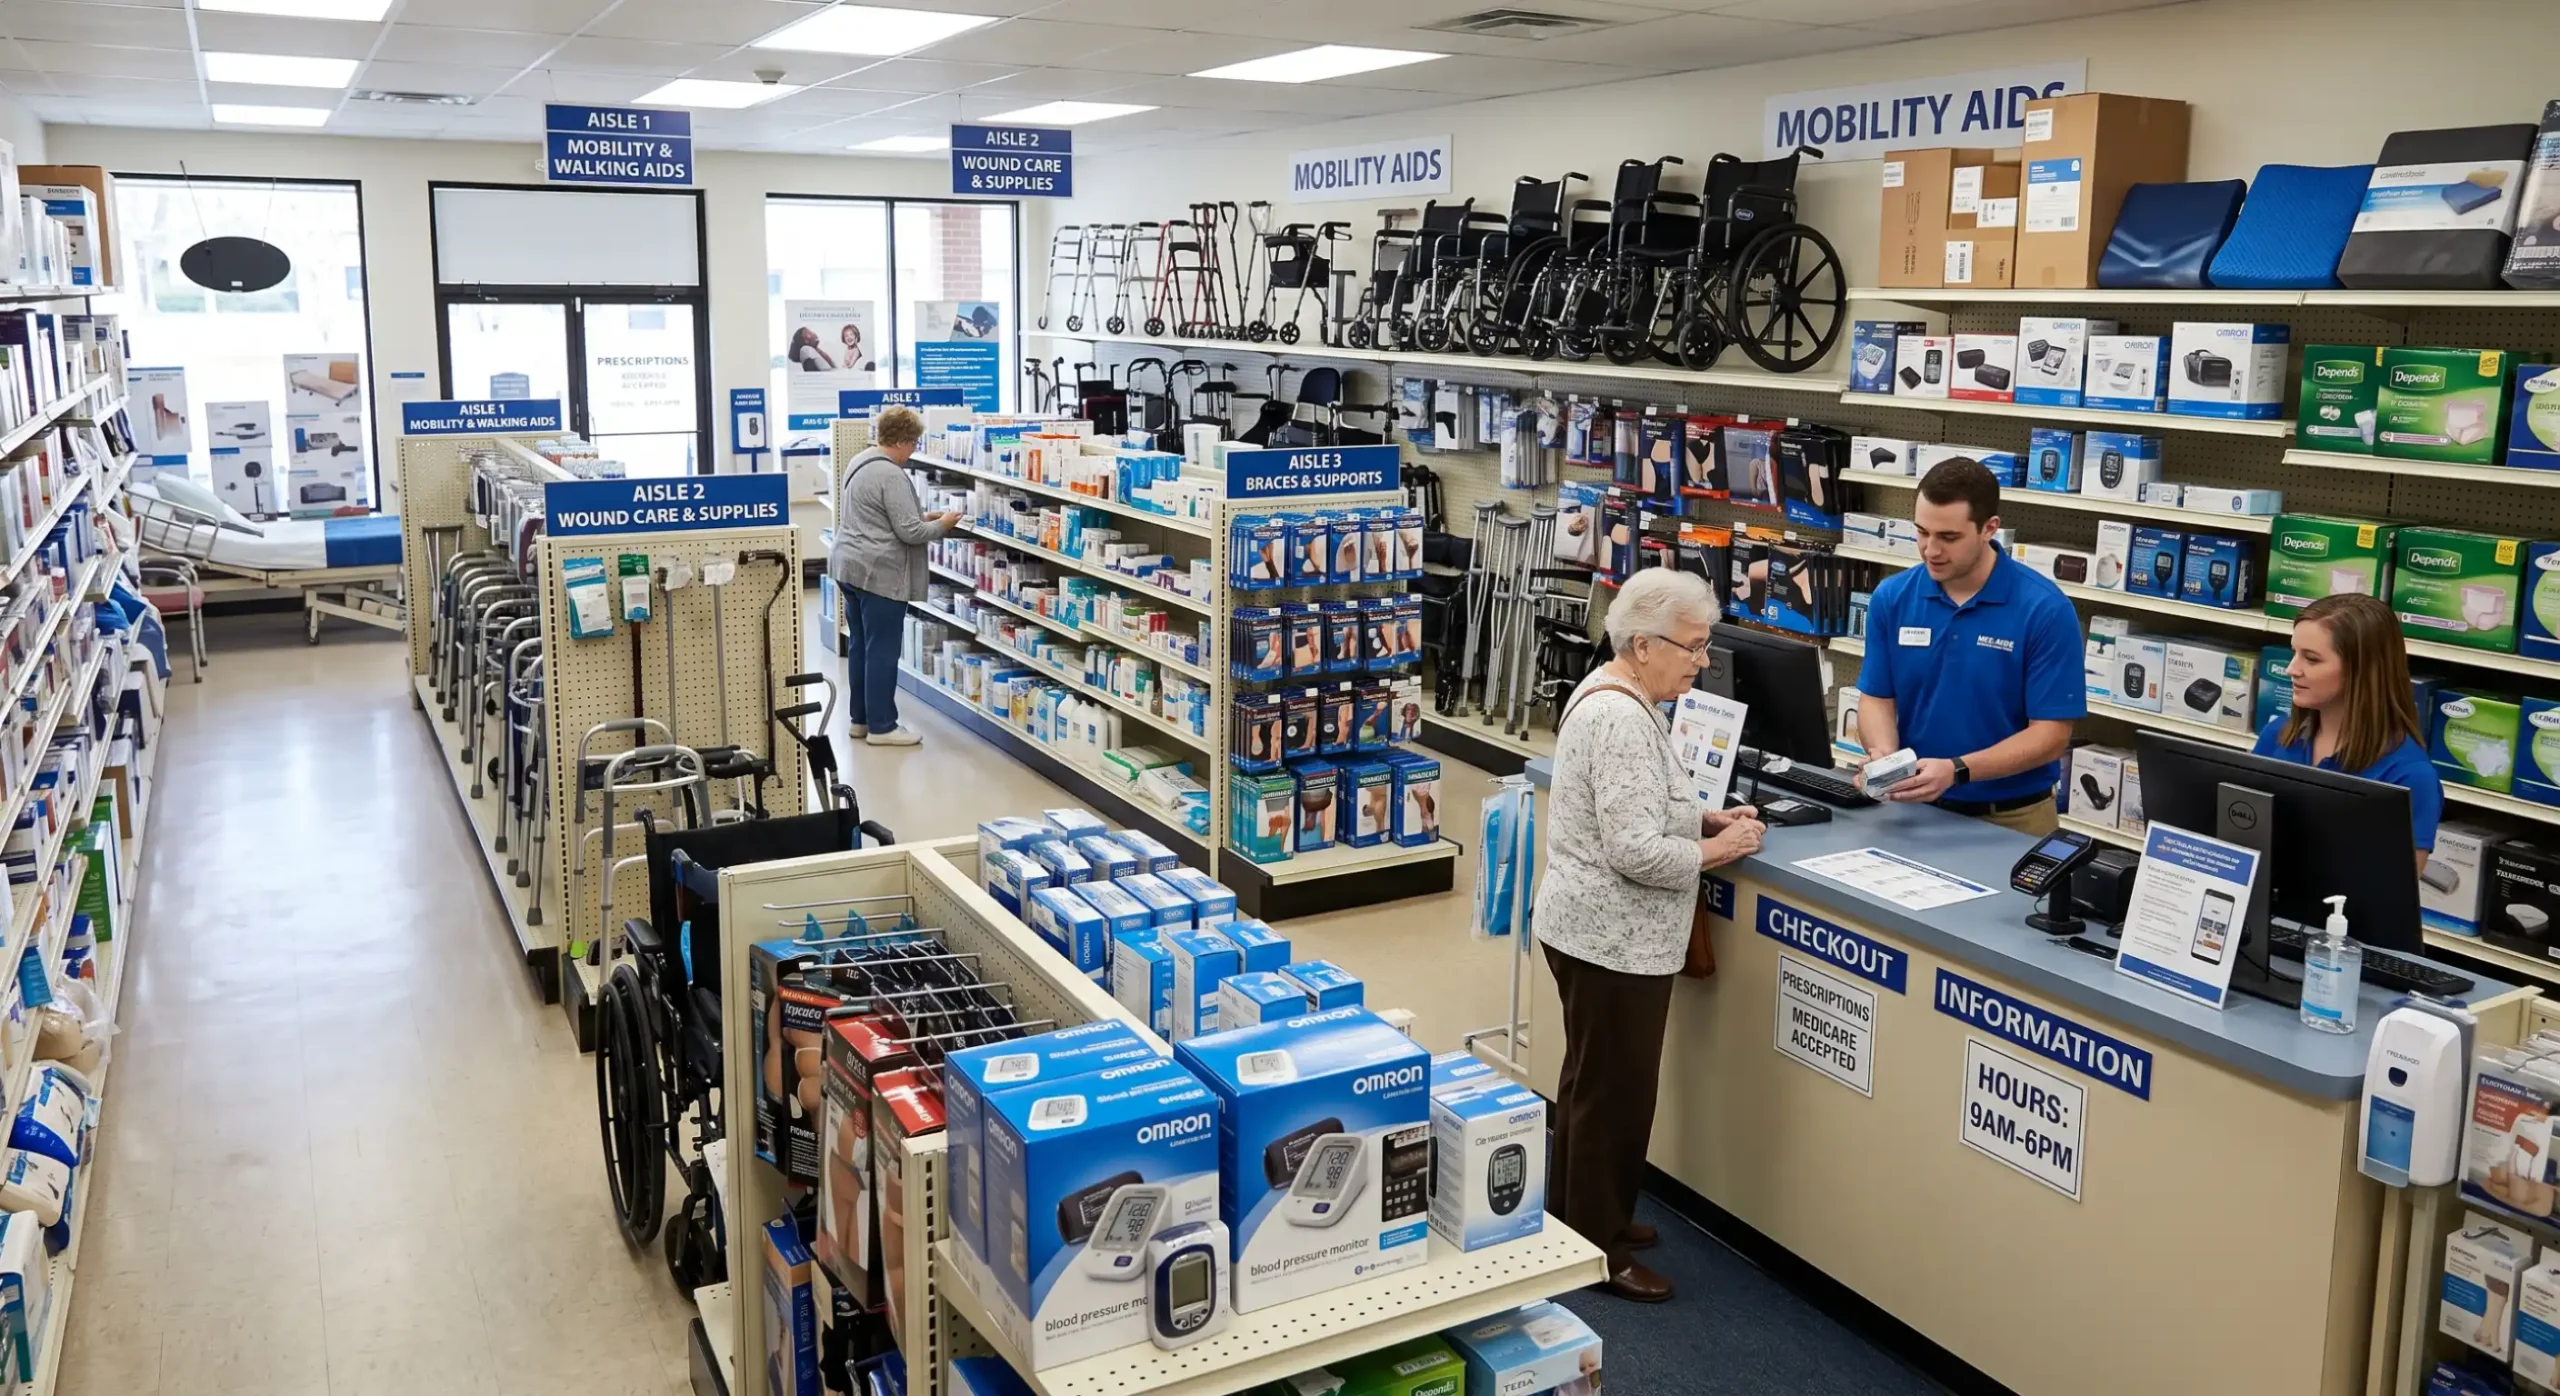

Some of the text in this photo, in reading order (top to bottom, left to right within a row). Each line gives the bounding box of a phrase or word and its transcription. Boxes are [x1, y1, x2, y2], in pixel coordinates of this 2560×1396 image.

[587, 112, 650, 130] AISLE 1
[1777, 94, 1953, 148] MOBILITY
[568, 139, 673, 158] MOBILITY &
[986, 131, 1039, 146] AISLE 2
[554, 159, 685, 178] WALKING AIDS
[962, 156, 1062, 173] WOUND CARE
[1295, 149, 1441, 191] MOBILITY AIDS
[971, 175, 1053, 191] & SUPPLIES
[597, 356, 689, 366] PRESCRIPTIONS
[2317, 365, 2358, 378] Depends
[2395, 371, 2441, 384] Depends
[882, 393, 912, 402] AISLE
[460, 404, 505, 415] AISLE 1
[410, 416, 556, 430] MOBILITY & WALKING AIDS
[1289, 454, 1341, 470] AISLE 3
[1246, 471, 1382, 491] BRACES & SUPPORTS
[632, 483, 705, 502] AISLE 2
[558, 503, 778, 528] WOUND CARE & SUPPLIES
[2284, 536, 2324, 550] Depends
[1768, 909, 1893, 979] CHECKOUT
[1783, 970, 1870, 1022] PRESCRIPTIONS
[1793, 1007, 1857, 1051] MEDICARE
[1941, 978, 2143, 1089] INFORMATION
[1791, 1029, 1856, 1072] ACCEPTED
[1101, 1059, 1171, 1080] OMRON
[1353, 1065, 1422, 1095] OMRON
[1978, 1062, 2068, 1128] HOURS:
[1137, 1113, 1211, 1144] OMRON
[1970, 1102, 2072, 1173] 9AM-6PM
[1250, 1238, 1369, 1276] blood pressure monitor
[1045, 1313, 1078, 1332] blood
[1081, 1302, 1129, 1325] pressure
